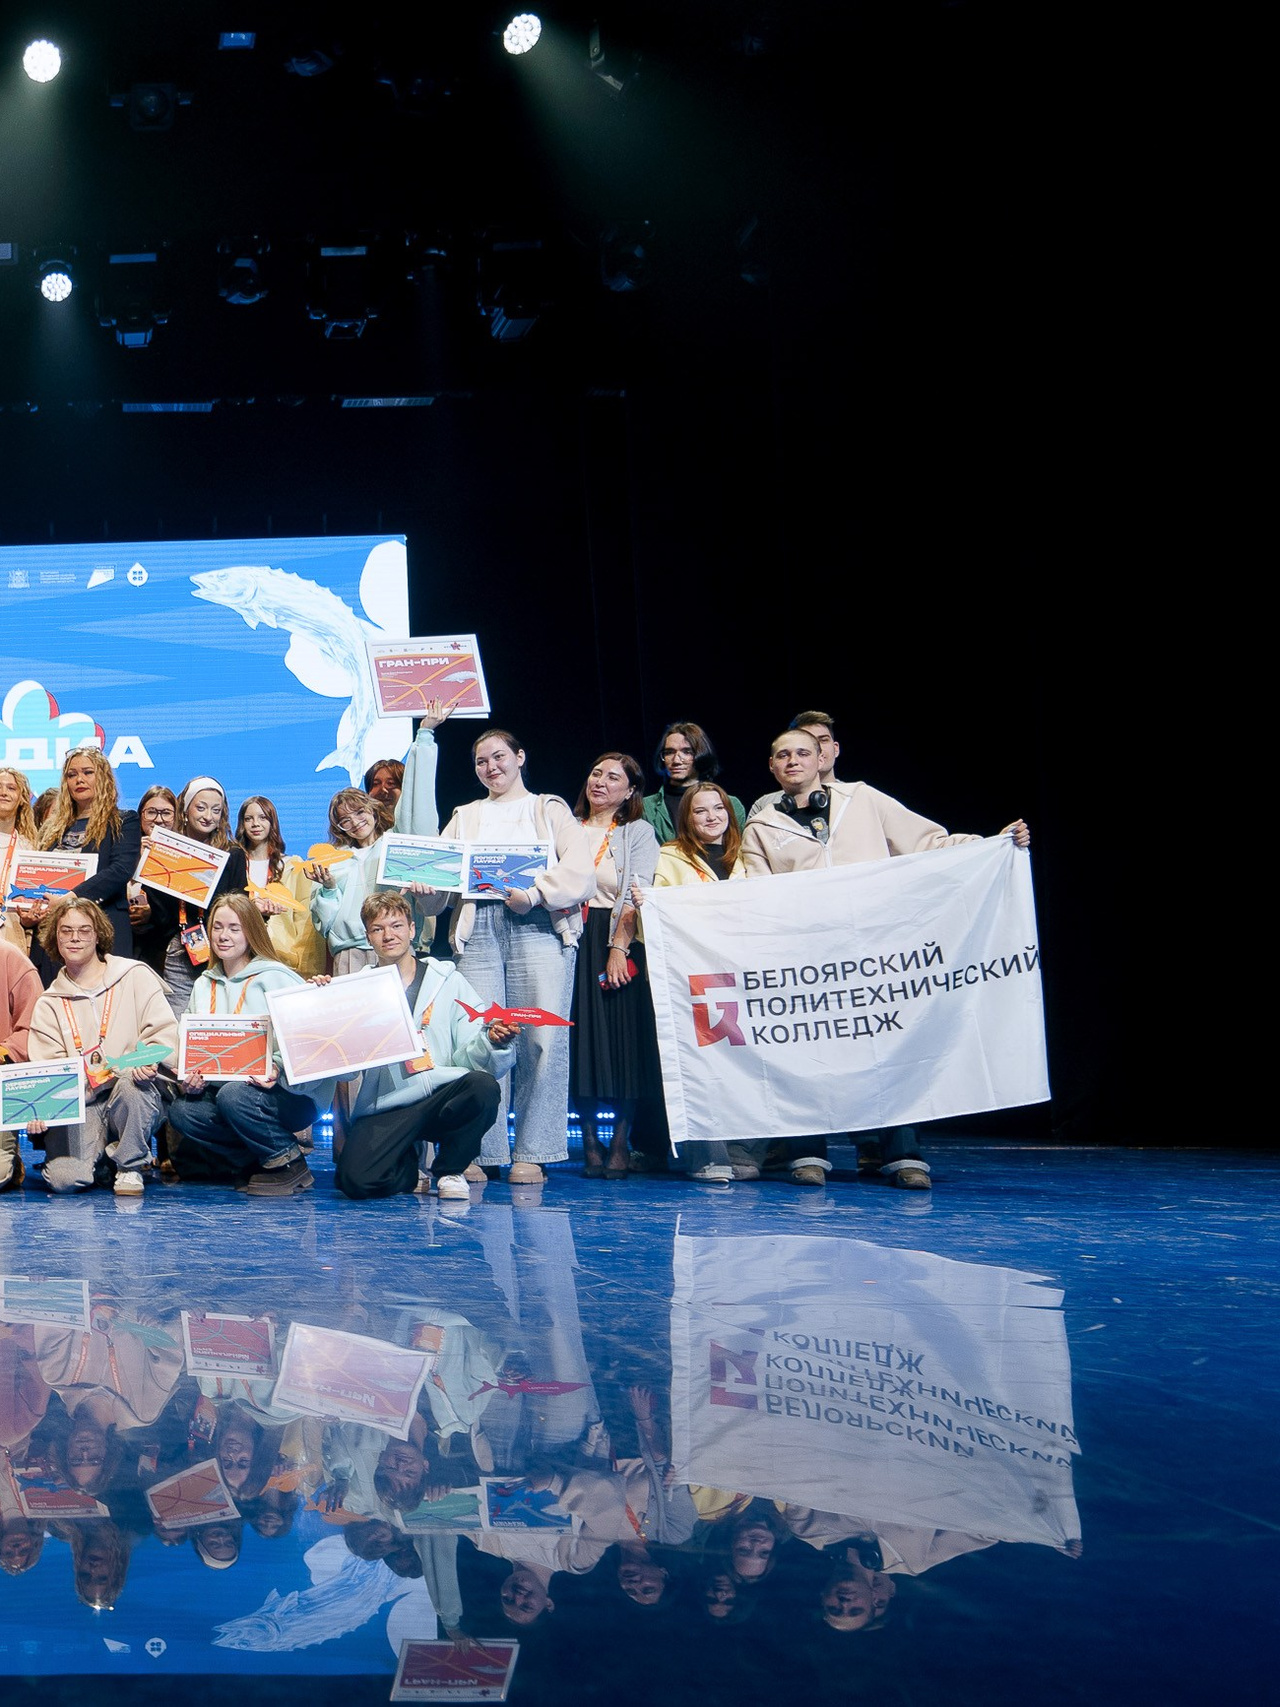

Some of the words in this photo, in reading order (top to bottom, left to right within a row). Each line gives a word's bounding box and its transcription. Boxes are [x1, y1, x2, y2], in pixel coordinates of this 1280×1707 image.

[378, 657, 451, 668] ГРАН-ПРИ
[742, 941, 944, 991] БЕЛОЯРСКИЙ
[746, 944, 1041, 1018] ПОЛИТЕХНИЧЕСКИЙ
[750, 1010, 904, 1046] КОЛЛЕДЖ
